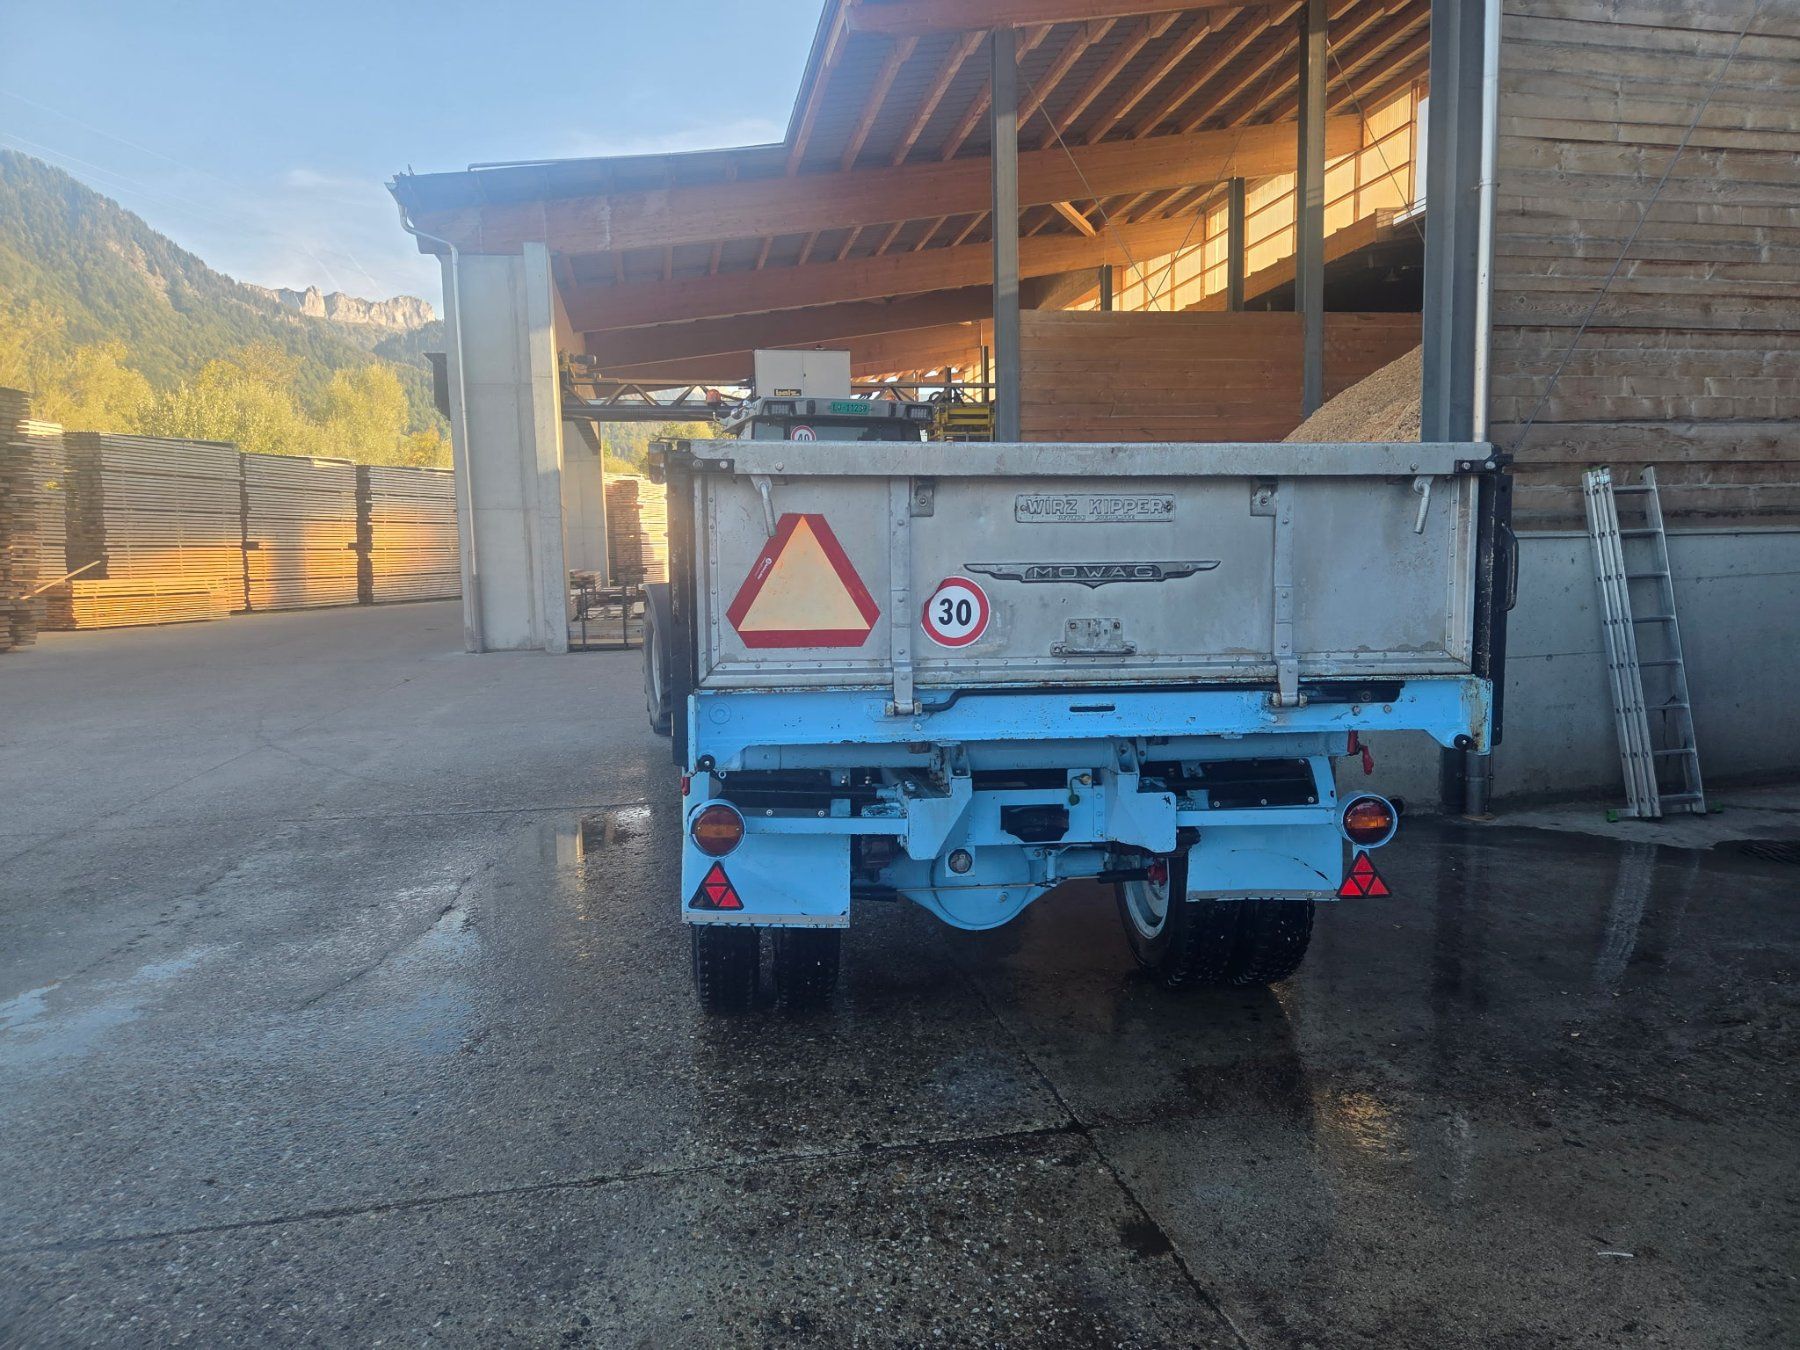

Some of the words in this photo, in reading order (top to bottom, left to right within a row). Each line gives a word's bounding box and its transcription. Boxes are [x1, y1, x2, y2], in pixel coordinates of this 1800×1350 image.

[1027, 498, 1077, 515] WIRZ
[1089, 498, 1163, 515] KIPPER
[1032, 566, 1154, 578] MOWAG
[938, 597, 972, 626] 30
